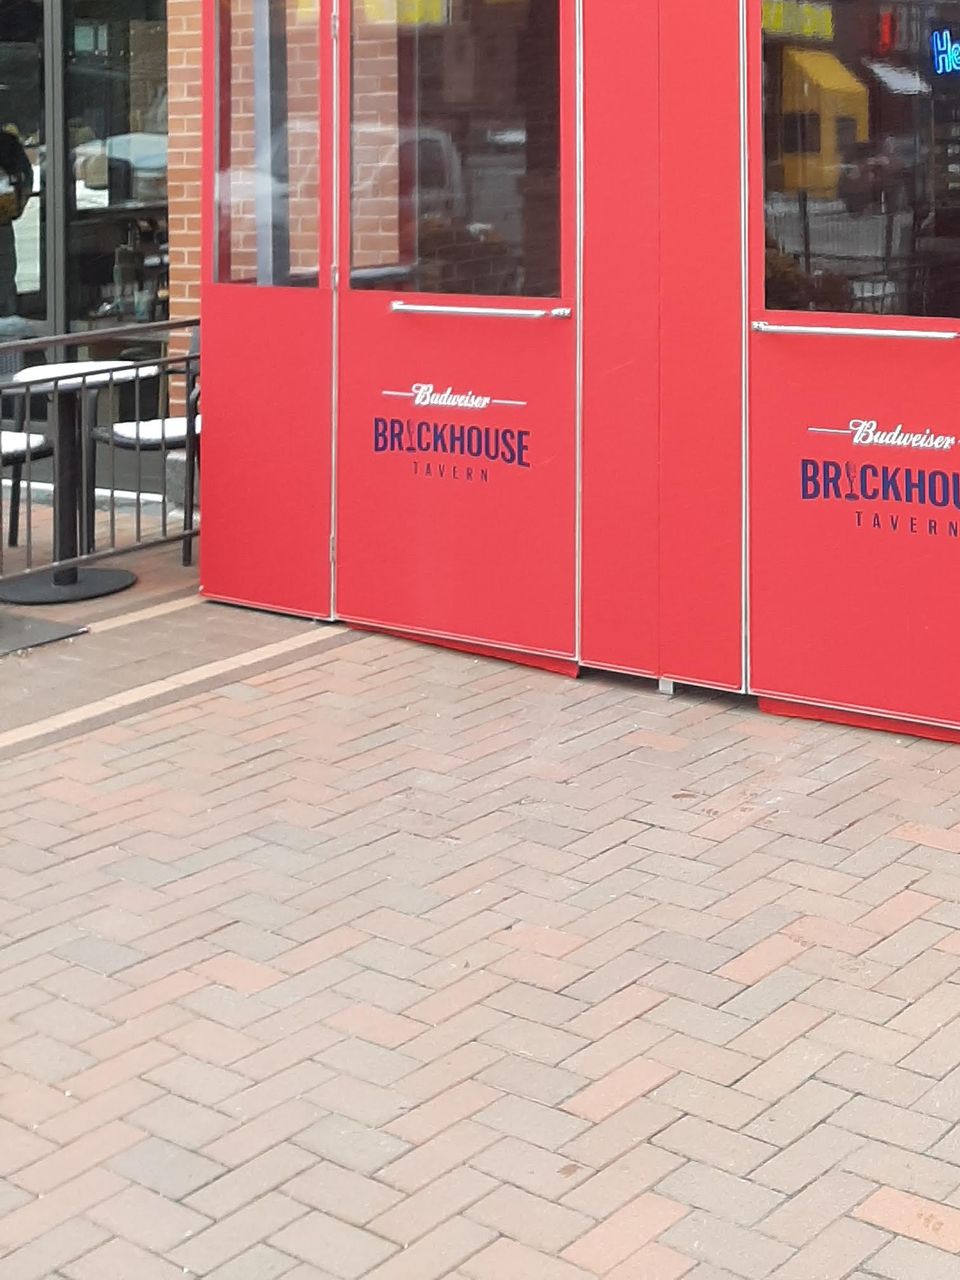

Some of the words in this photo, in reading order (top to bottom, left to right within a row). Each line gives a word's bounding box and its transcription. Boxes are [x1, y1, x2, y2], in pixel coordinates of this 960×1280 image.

[411, 383, 490, 409] Budweiser
[849, 419, 955, 449] Budweiser
[412, 461, 488, 482] TAVERN
[855, 511, 958, 537] TAVERN
